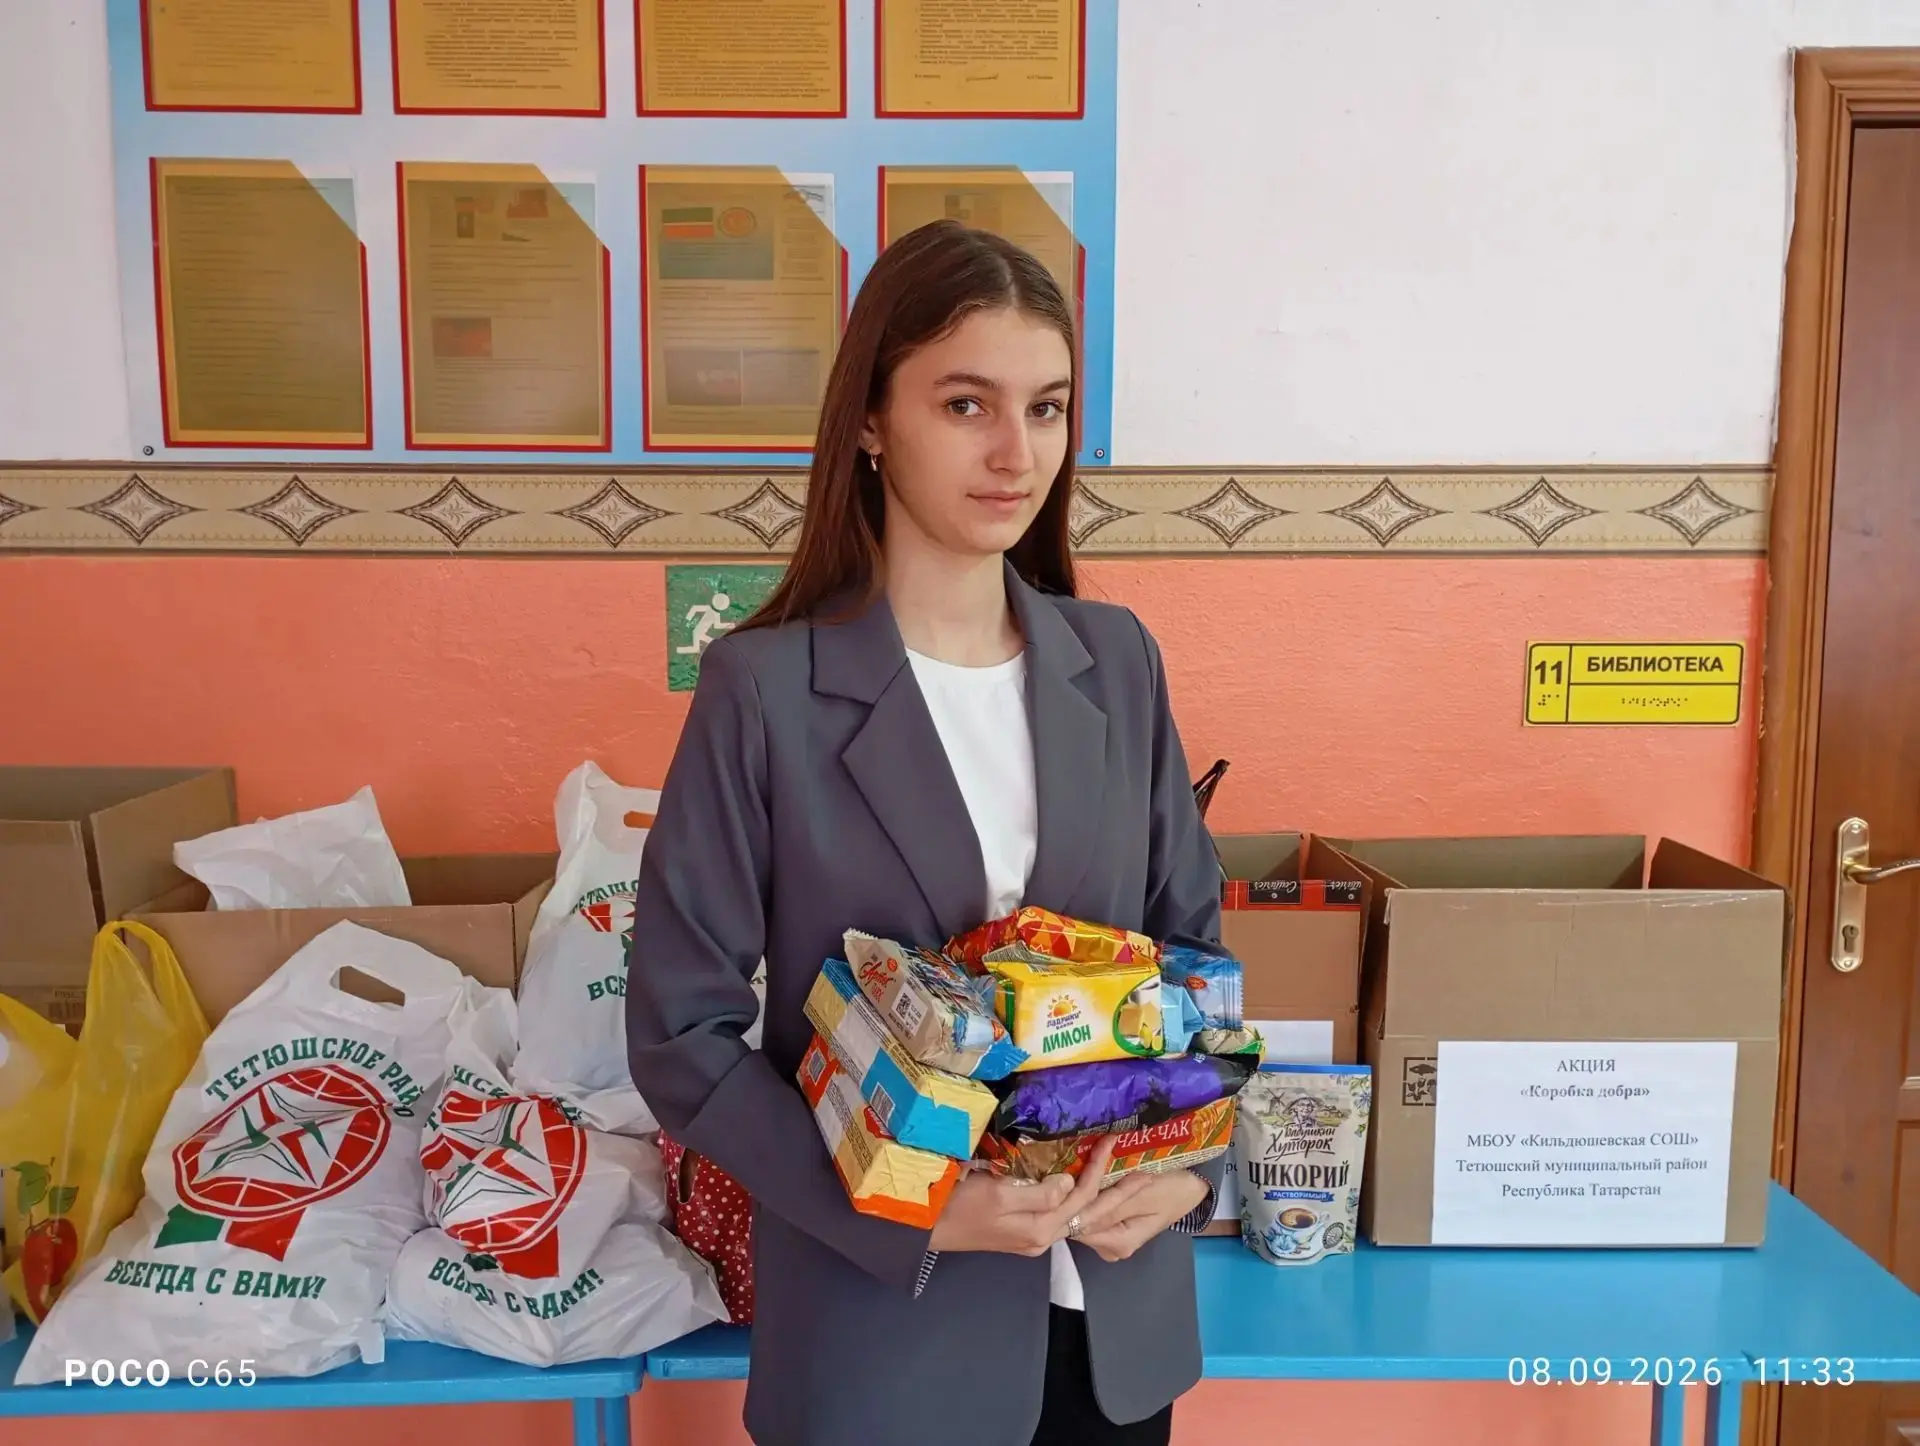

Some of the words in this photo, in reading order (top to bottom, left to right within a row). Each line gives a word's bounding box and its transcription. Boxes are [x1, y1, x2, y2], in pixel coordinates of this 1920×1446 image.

[1534, 660, 1563, 685] 11
[1587, 656, 1724, 672] БИБЛИОТЕКА
[587, 975, 627, 1001] ВСЕ
[1042, 1025, 1091, 1053] ЛИМОН
[205, 1037, 386, 1101] ТЕТЮШСКОЕ
[1557, 1059, 1616, 1074] АКЦИЯ
[1520, 1084, 1594, 1100] «Коробка
[1597, 1085, 1650, 1099] добра»
[1117, 1118, 1192, 1148] ЧАК-ЧАК
[1266, 1130, 1334, 1161] Хуторок
[1466, 1134, 1516, 1147] МБОУ
[1520, 1134, 1646, 1148] «Кильдюшевская
[1650, 1132, 1699, 1146] СОШ»
[1248, 1160, 1350, 1190] ЦИКОРИЙ
[1456, 1159, 1541, 1173] Тетюшский
[1544, 1158, 1662, 1173] муниципальный
[1665, 1158, 1708, 1173] район
[1272, 1191, 1328, 1200] РАСТВОРИМЫЙ
[1502, 1184, 1585, 1199] Республика
[1589, 1183, 1661, 1199] Татарстан
[104, 1260, 197, 1295] ВСЕГДА
[205, 1268, 227, 1295] С
[232, 1270, 327, 1299] ВАМИ!
[504, 1291, 521, 1313] С
